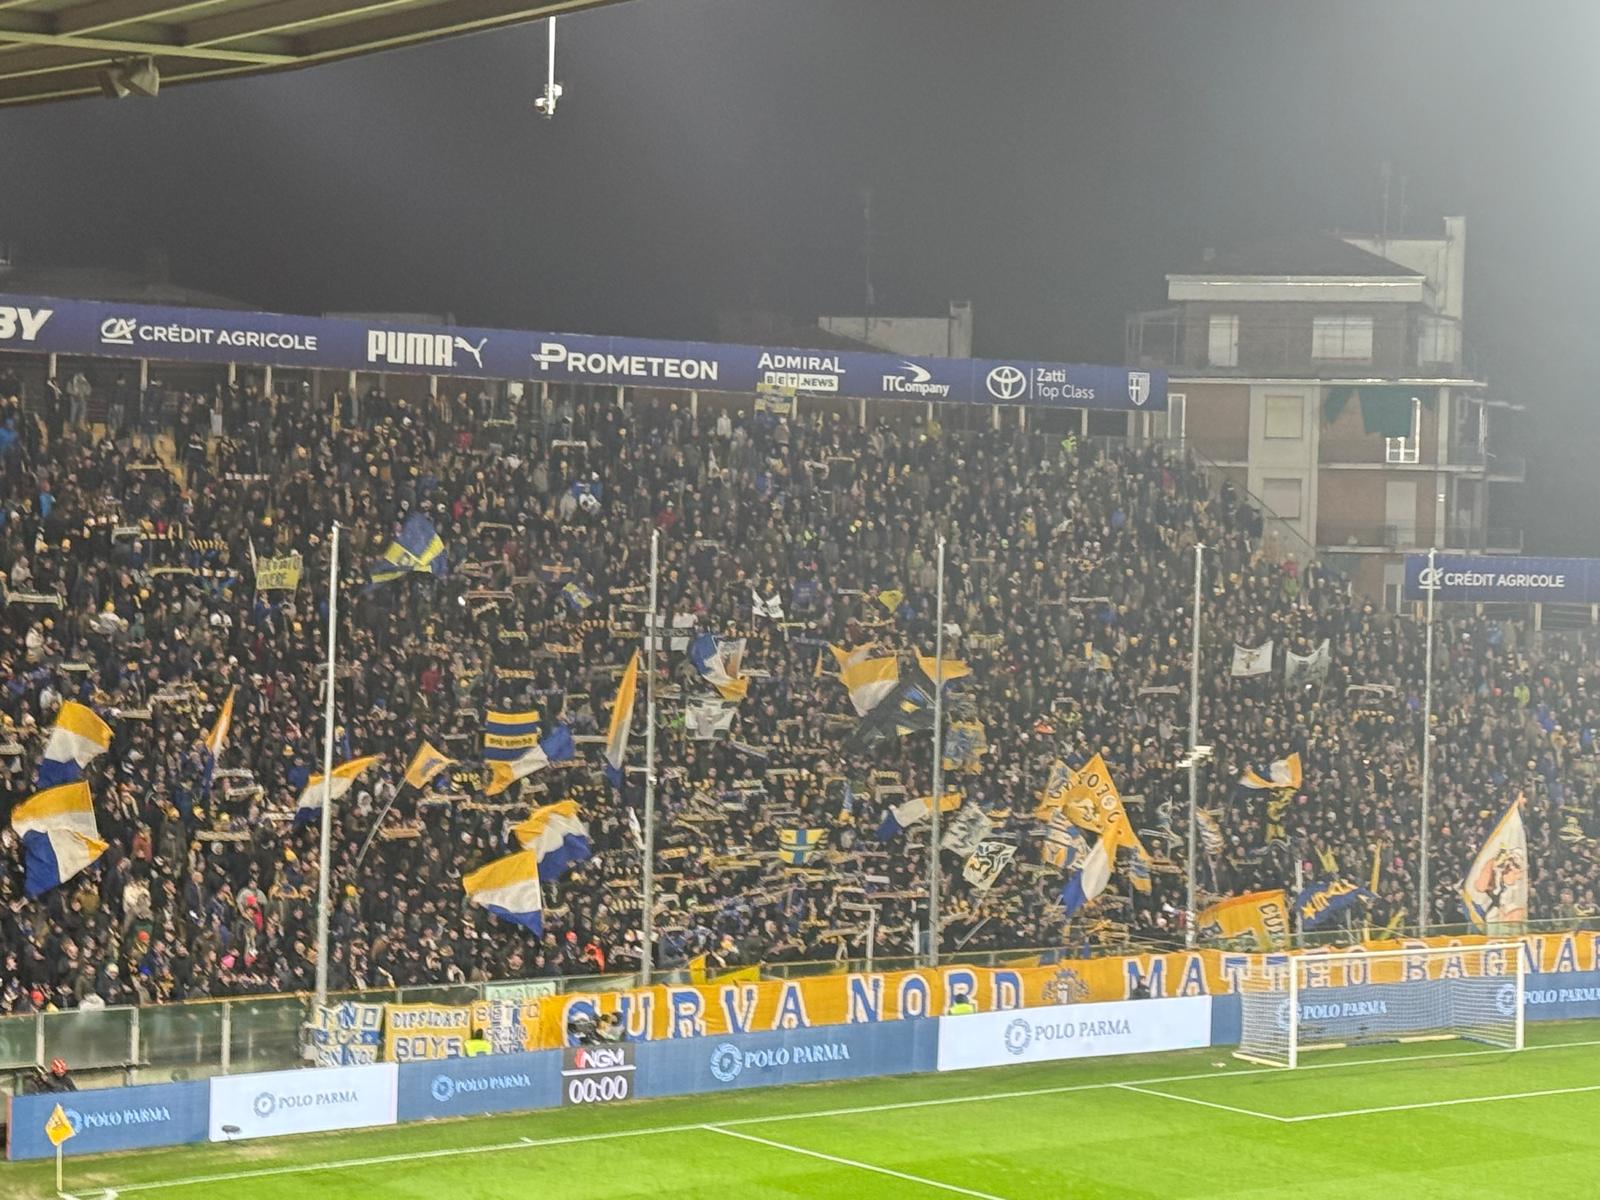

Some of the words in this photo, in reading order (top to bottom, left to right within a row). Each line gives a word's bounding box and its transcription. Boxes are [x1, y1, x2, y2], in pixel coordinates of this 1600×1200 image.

[139, 324, 214, 344] CRÉDIT
[217, 329, 318, 350] AGRICOLE
[367, 329, 454, 367] PUMA
[533, 342, 719, 380] PROMETEON
[757, 352, 846, 373] ADMIRAL
[1037, 368, 1066, 383] Zatti
[1037, 383, 1059, 400] Top
[1062, 384, 1095, 399] Class
[1445, 570, 1495, 586] CRÉDIT
[1497, 574, 1566, 588] AGRICOLE
[563, 982, 811, 1046] CURVA
[848, 968, 1024, 1024] NORD
[1401, 929, 1600, 981] BAGNA
[1302, 1004, 1341, 1020] POLO
[1342, 1001, 1387, 1017] PARMA
[1035, 1023, 1075, 1041] POLO
[1079, 1019, 1131, 1037] PARMA
[744, 1047, 790, 1069] POLO
[793, 1042, 851, 1064] PARMA
[455, 1078, 489, 1093] POLO
[490, 1074, 531, 1090] PARMA
[568, 1075, 628, 1104] 00:00
[279, 1095, 313, 1109] POLO
[316, 1090, 359, 1106] PARMA
[83, 1110, 122, 1128] POLO
[123, 1106, 171, 1124] PARMA
